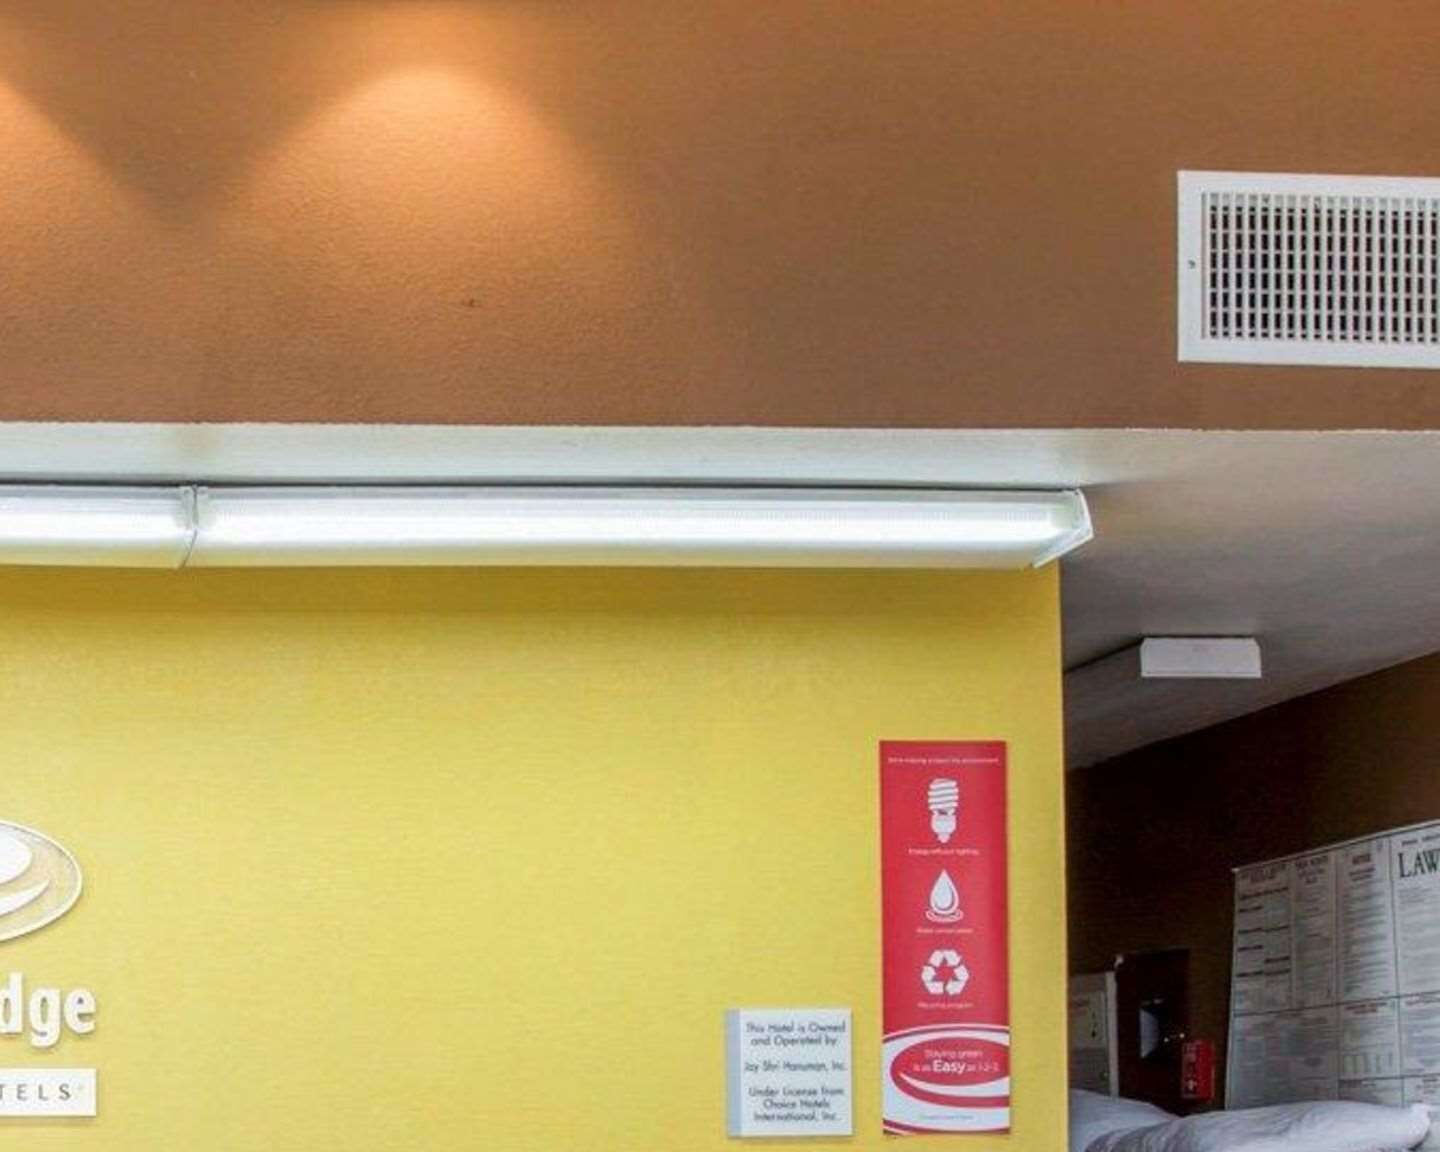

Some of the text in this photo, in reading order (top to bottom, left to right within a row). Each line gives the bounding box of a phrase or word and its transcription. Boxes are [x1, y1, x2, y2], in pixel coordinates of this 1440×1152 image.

[746, 1020, 846, 1033] This Hotel is Owned
[750, 1034, 838, 1048] and Operated by
[932, 1059, 967, 1075] Easy
[748, 1086, 845, 1097] Under License from
[762, 1098, 831, 1110] Choice Hotels
